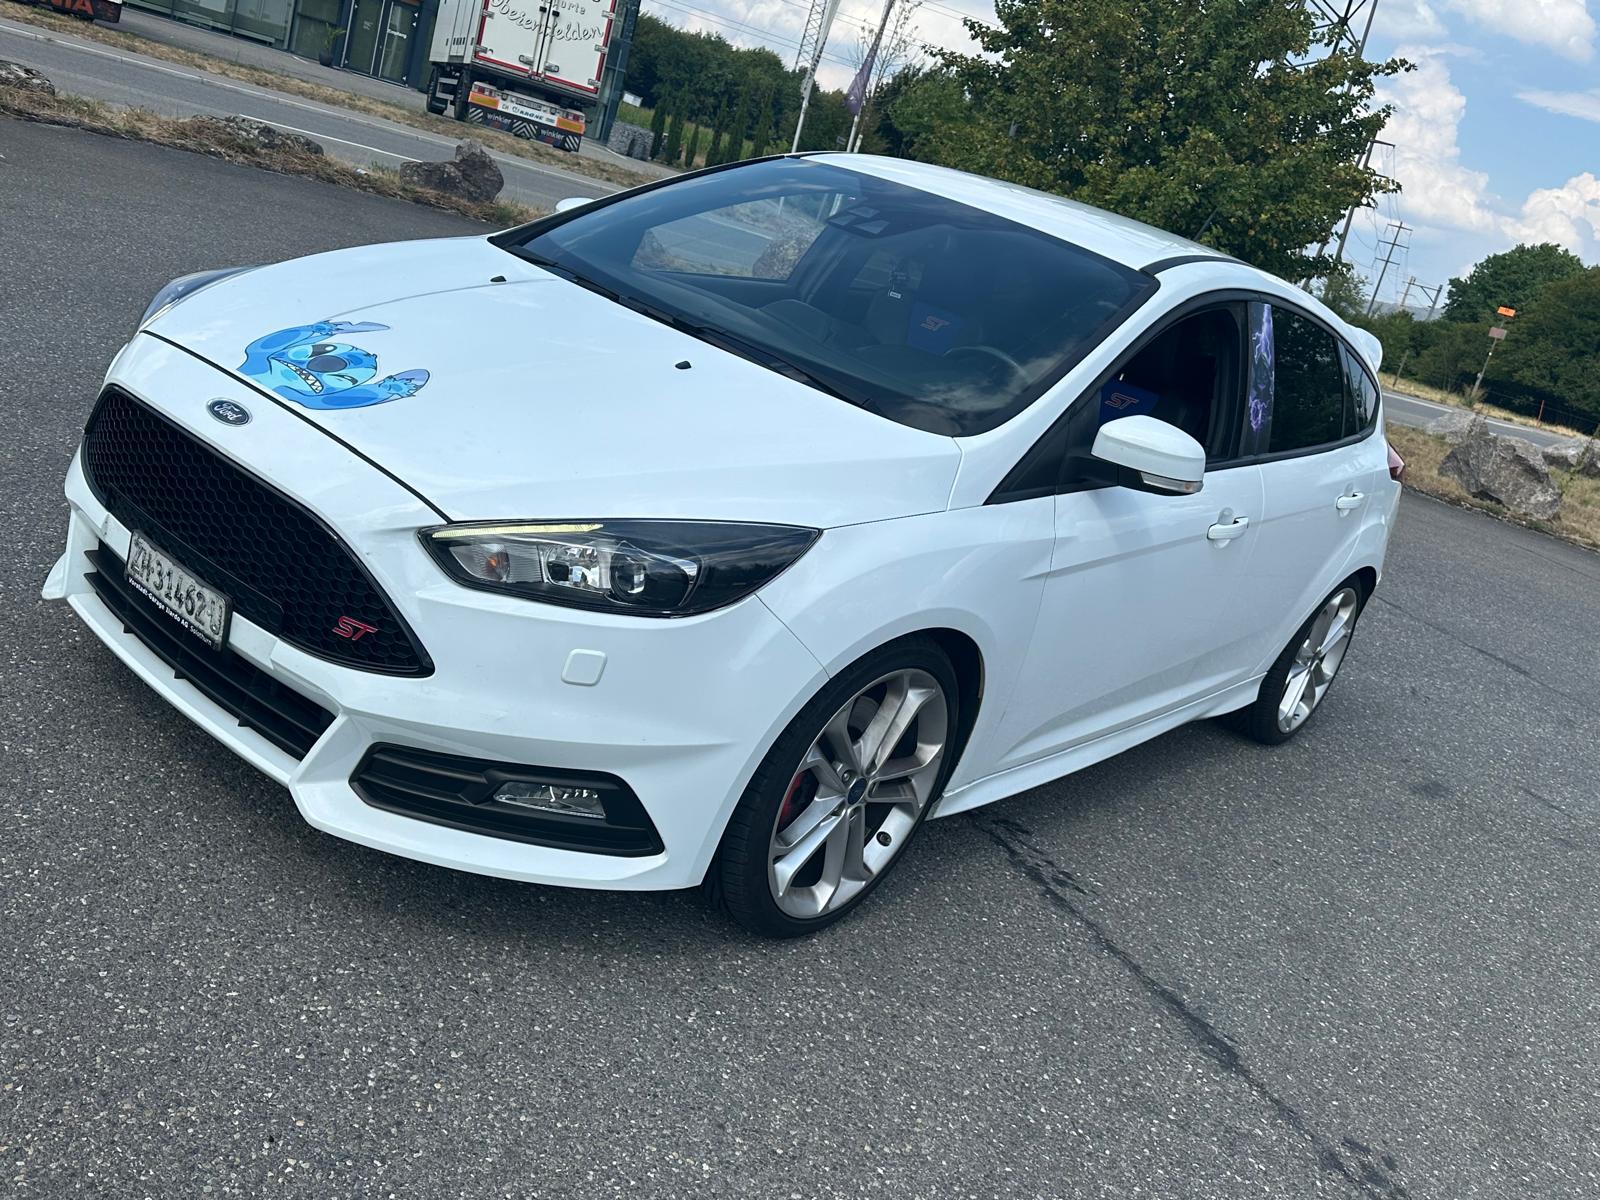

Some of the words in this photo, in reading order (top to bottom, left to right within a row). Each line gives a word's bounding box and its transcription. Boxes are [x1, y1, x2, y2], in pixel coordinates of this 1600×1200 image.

[920, 315, 951, 332] ST
[1104, 392, 1138, 409] ST
[213, 402, 243, 421] Ford
[331, 615, 379, 641] ST
